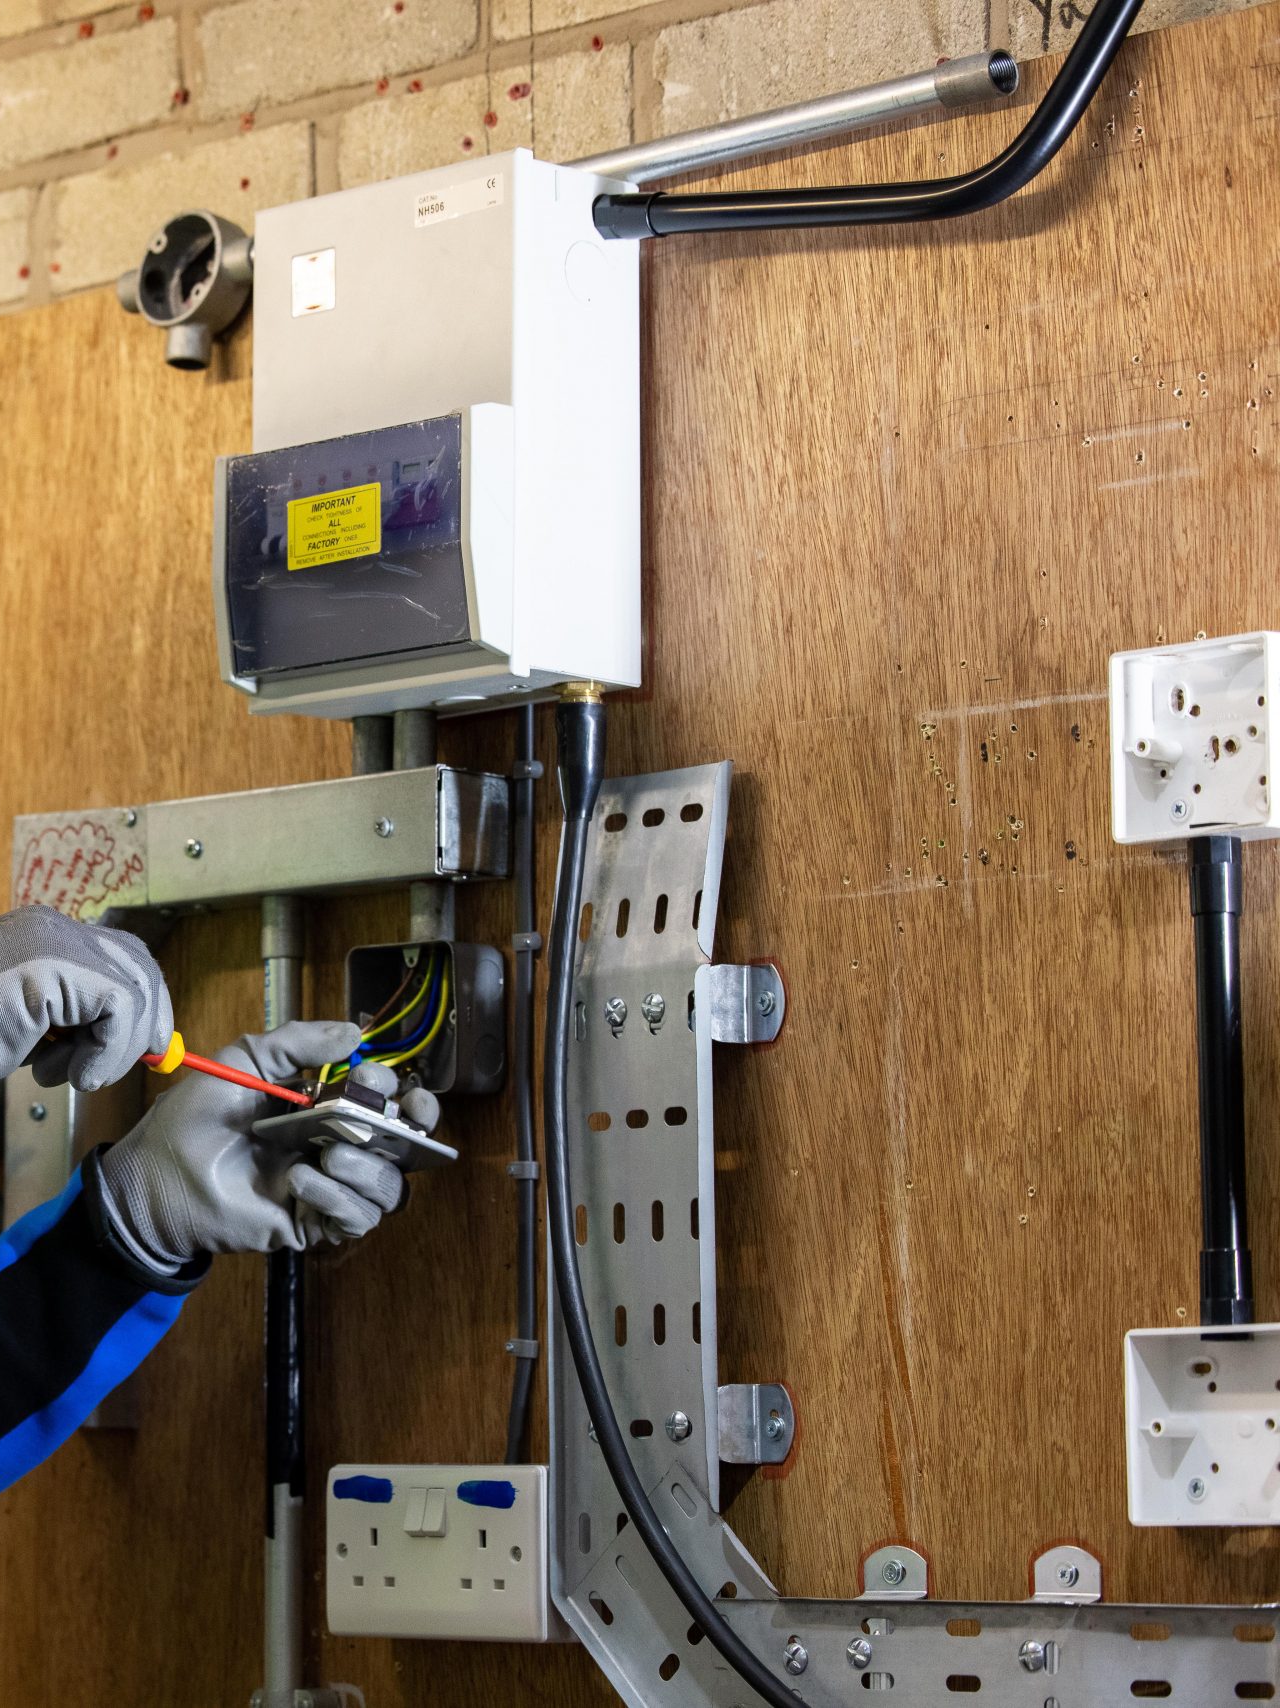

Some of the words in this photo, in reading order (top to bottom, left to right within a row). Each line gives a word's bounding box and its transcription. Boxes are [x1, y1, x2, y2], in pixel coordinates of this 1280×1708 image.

[418, 202, 445, 217] NH506
[312, 496, 356, 512] IMPORTANT
[328, 518, 341, 528] ALL
[302, 529, 336, 541] CONNECTIONS
[341, 523, 366, 533] INCLUDING
[307, 537, 340, 551] FACTORY
[319, 552, 335, 561] AFTER
[337, 546, 370, 557] INSTALLATION
